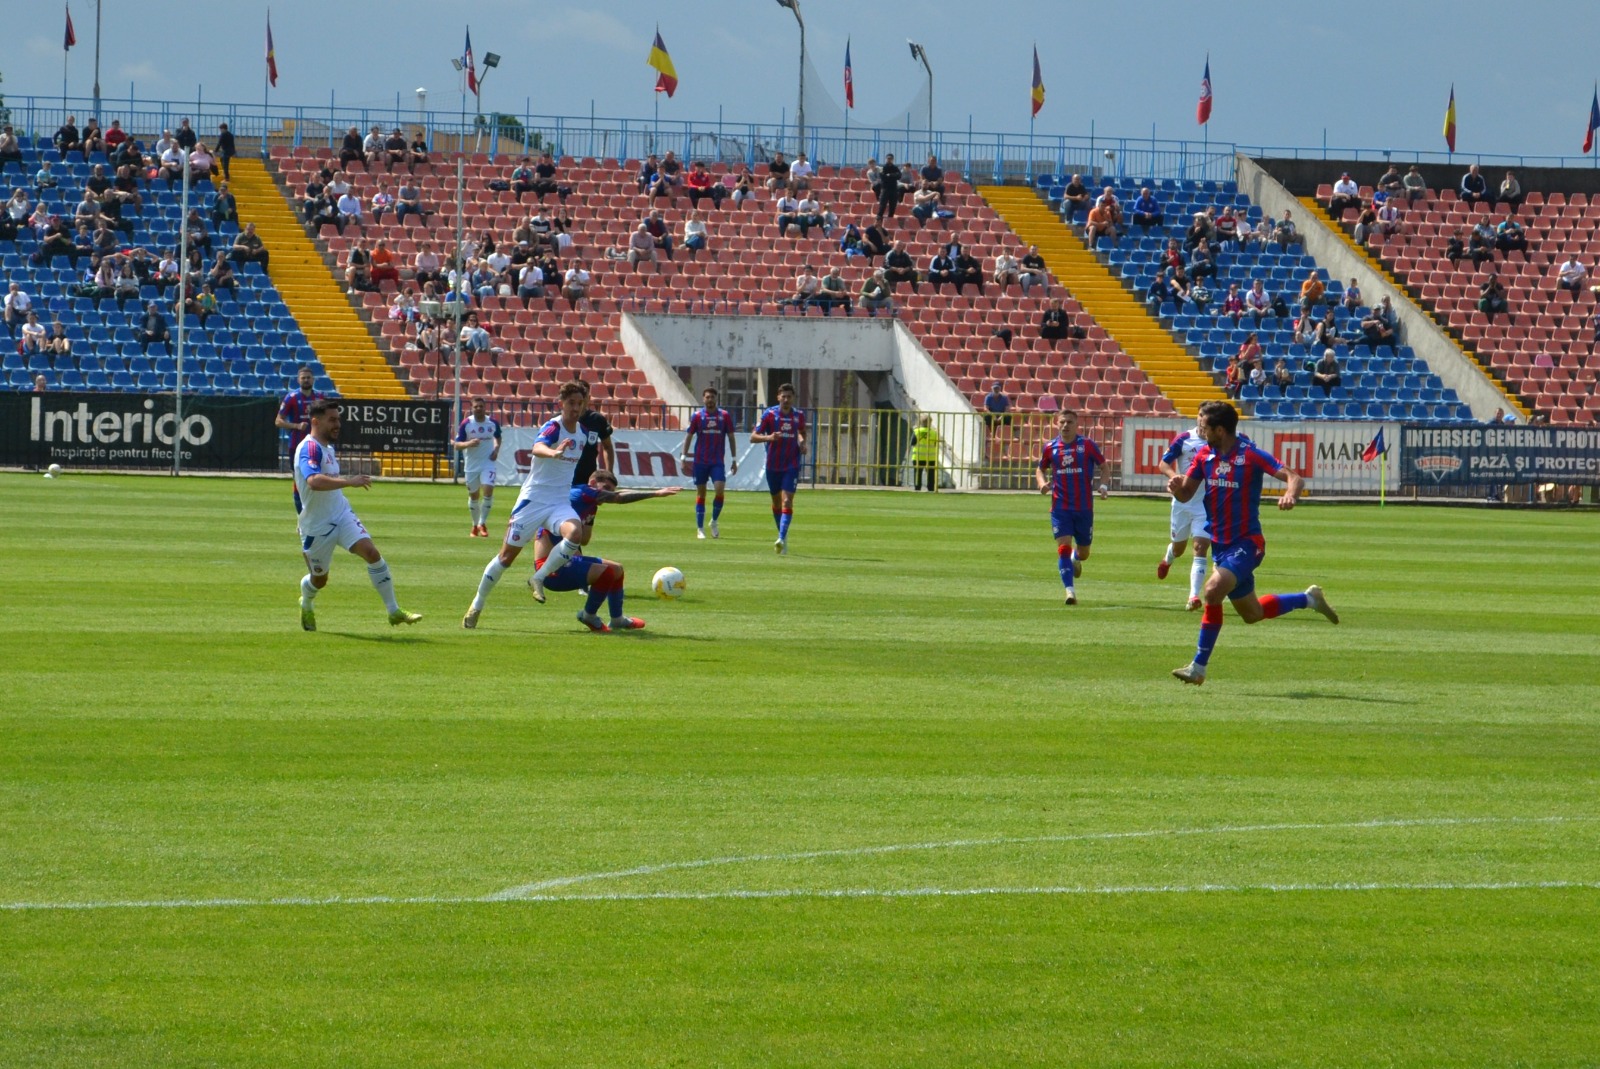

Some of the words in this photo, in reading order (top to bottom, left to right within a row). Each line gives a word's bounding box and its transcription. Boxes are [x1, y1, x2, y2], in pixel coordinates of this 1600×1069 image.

[360, 425, 413, 435] imobiliare
[1406, 429, 1482, 447] INTERSEC
[1485, 429, 1553, 448] GENERAL
[109, 448, 148, 460] pentru
[1317, 442, 1392, 460] MARY
[1470, 453, 1511, 468] PAZĂ
[1208, 478, 1239, 488] selina
